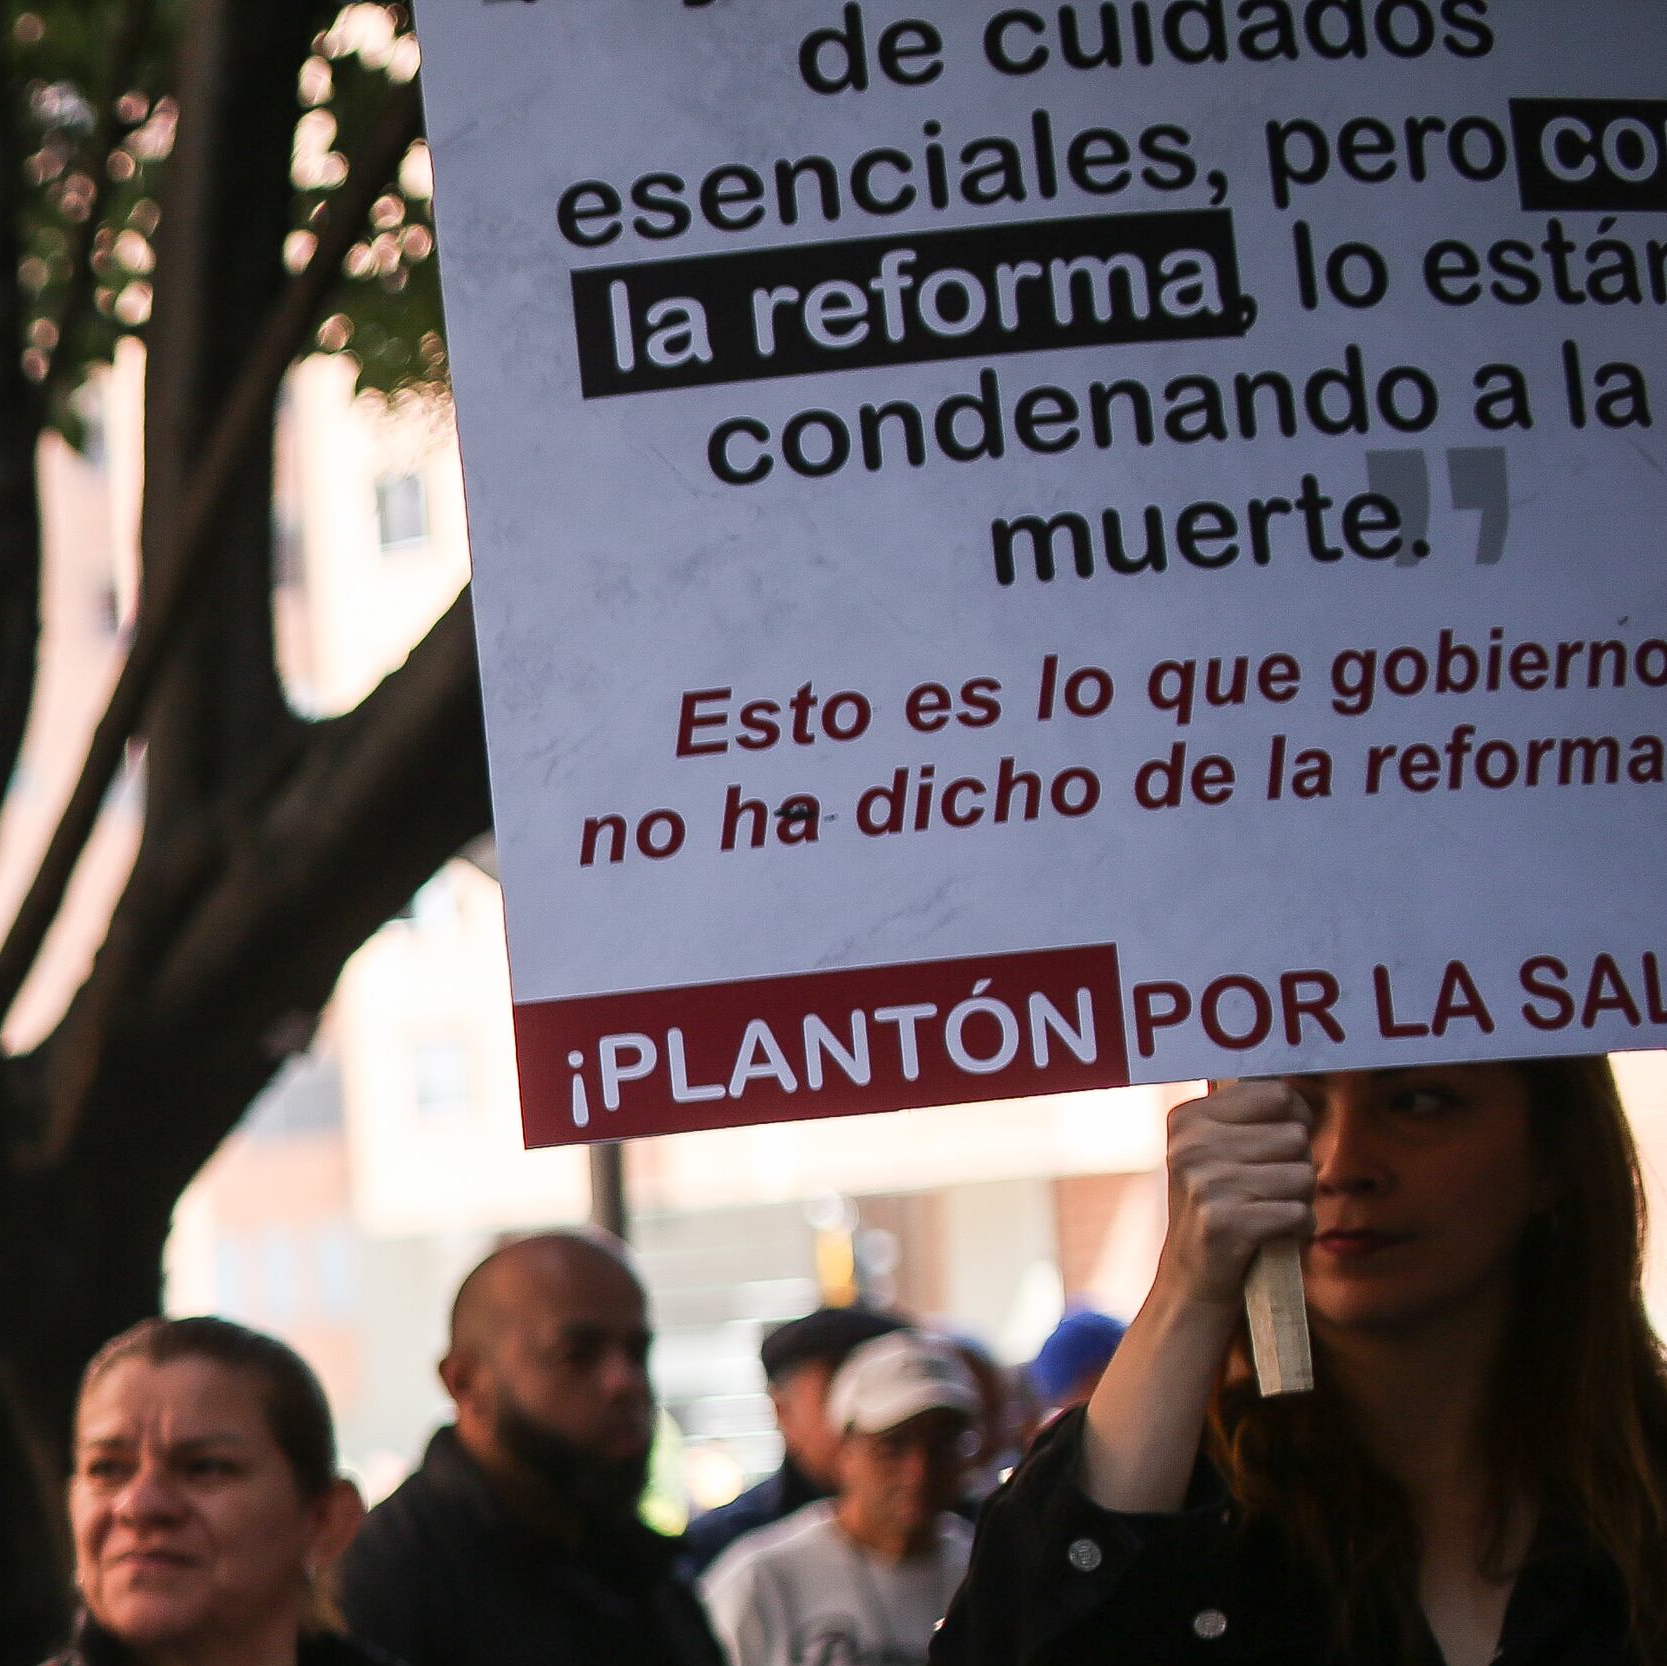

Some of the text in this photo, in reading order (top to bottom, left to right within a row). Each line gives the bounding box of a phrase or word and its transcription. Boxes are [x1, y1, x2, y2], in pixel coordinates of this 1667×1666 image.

[798, 0, 1497, 96] de cuidados
[555, 106, 1667, 248] esenciales, pero co
[609, 278, 710, 374] la
[751, 241, 1259, 356] reforma,
[1293, 219, 1389, 313] lo
[705, 337, 1652, 488] condenando a la
[675, 624, 1667, 761] Esto es lo que gobierno
[578, 804, 688, 867] no
[719, 782, 820, 852] ha
[855, 757, 1103, 838] dicho
[1133, 742, 1236, 814] de
[1266, 733, 1334, 801] la
[566, 977, 1096, 1131] ¡PLANTÓN
[1133, 967, 1344, 1060] POR
[1375, 958, 1496, 1041] LA
